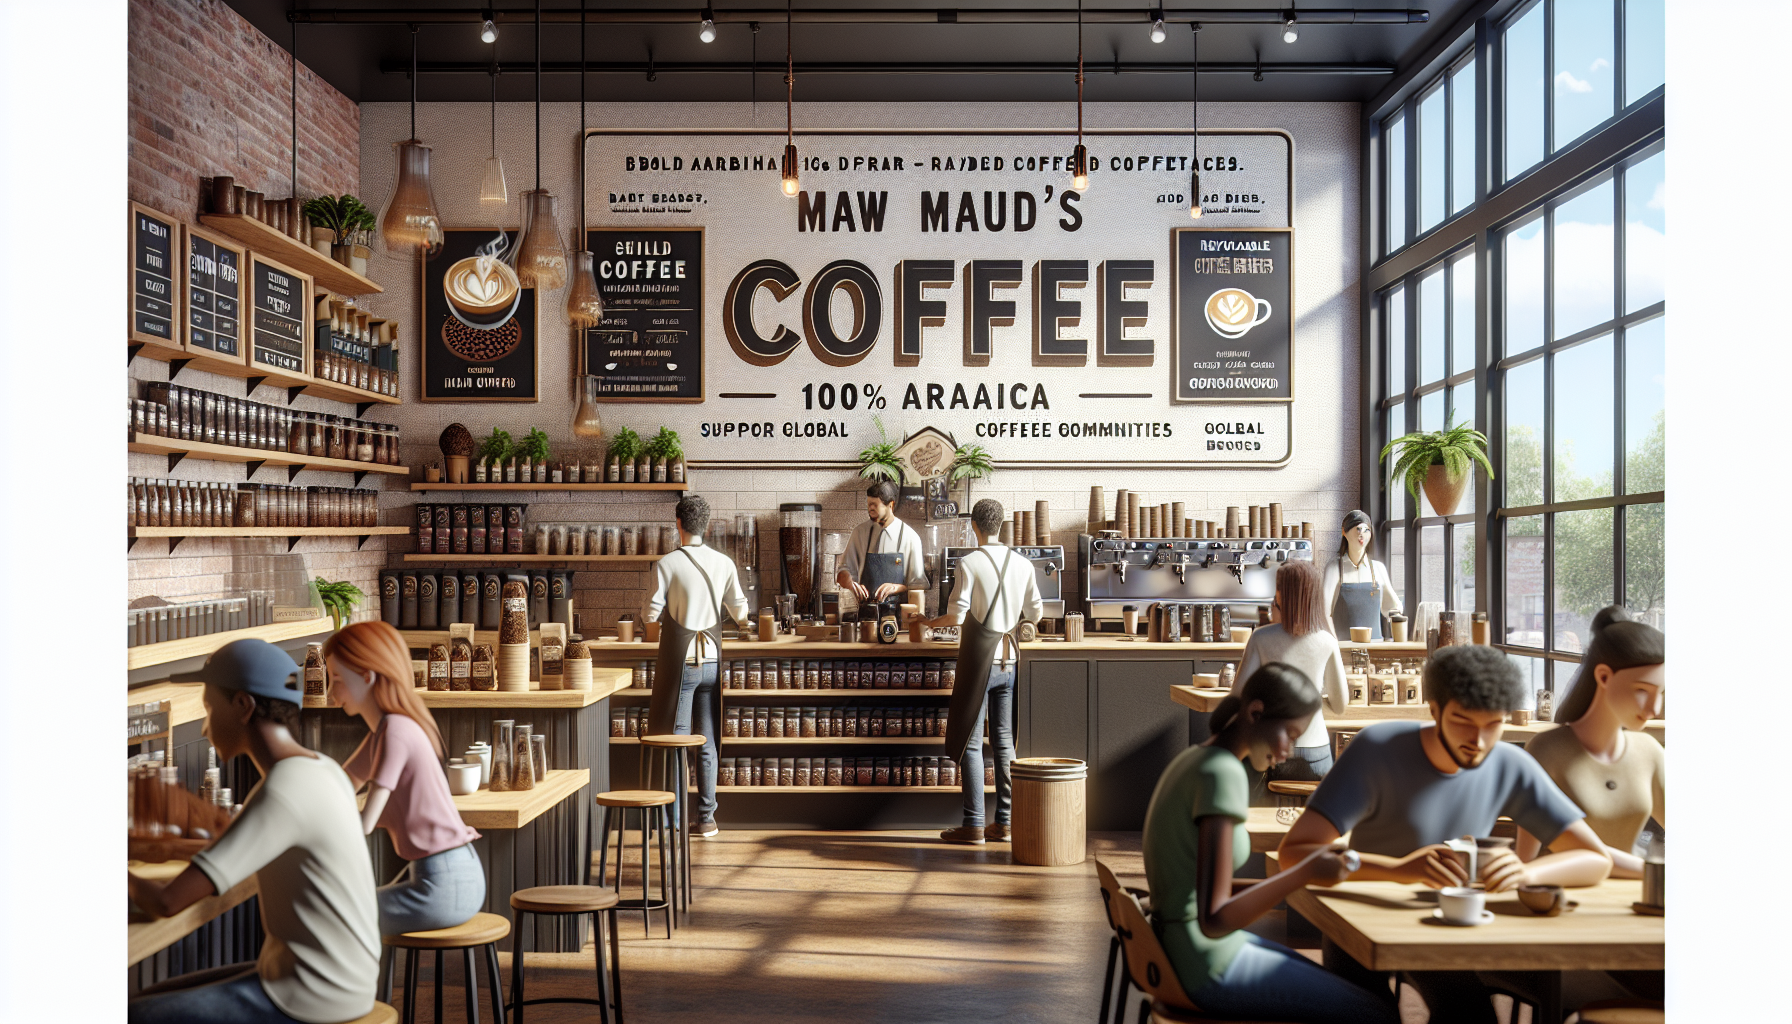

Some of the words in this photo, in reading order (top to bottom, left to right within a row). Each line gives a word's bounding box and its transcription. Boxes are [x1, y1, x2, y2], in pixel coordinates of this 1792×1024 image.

[798, 191, 888, 232] MAW
[921, 185, 1082, 232] MAUD'S
[600, 260, 686, 279] COFFEE
[723, 259, 1154, 367] COFFEE
[802, 383, 886, 410] 100%
[902, 383, 1049, 410] ARAAICA
